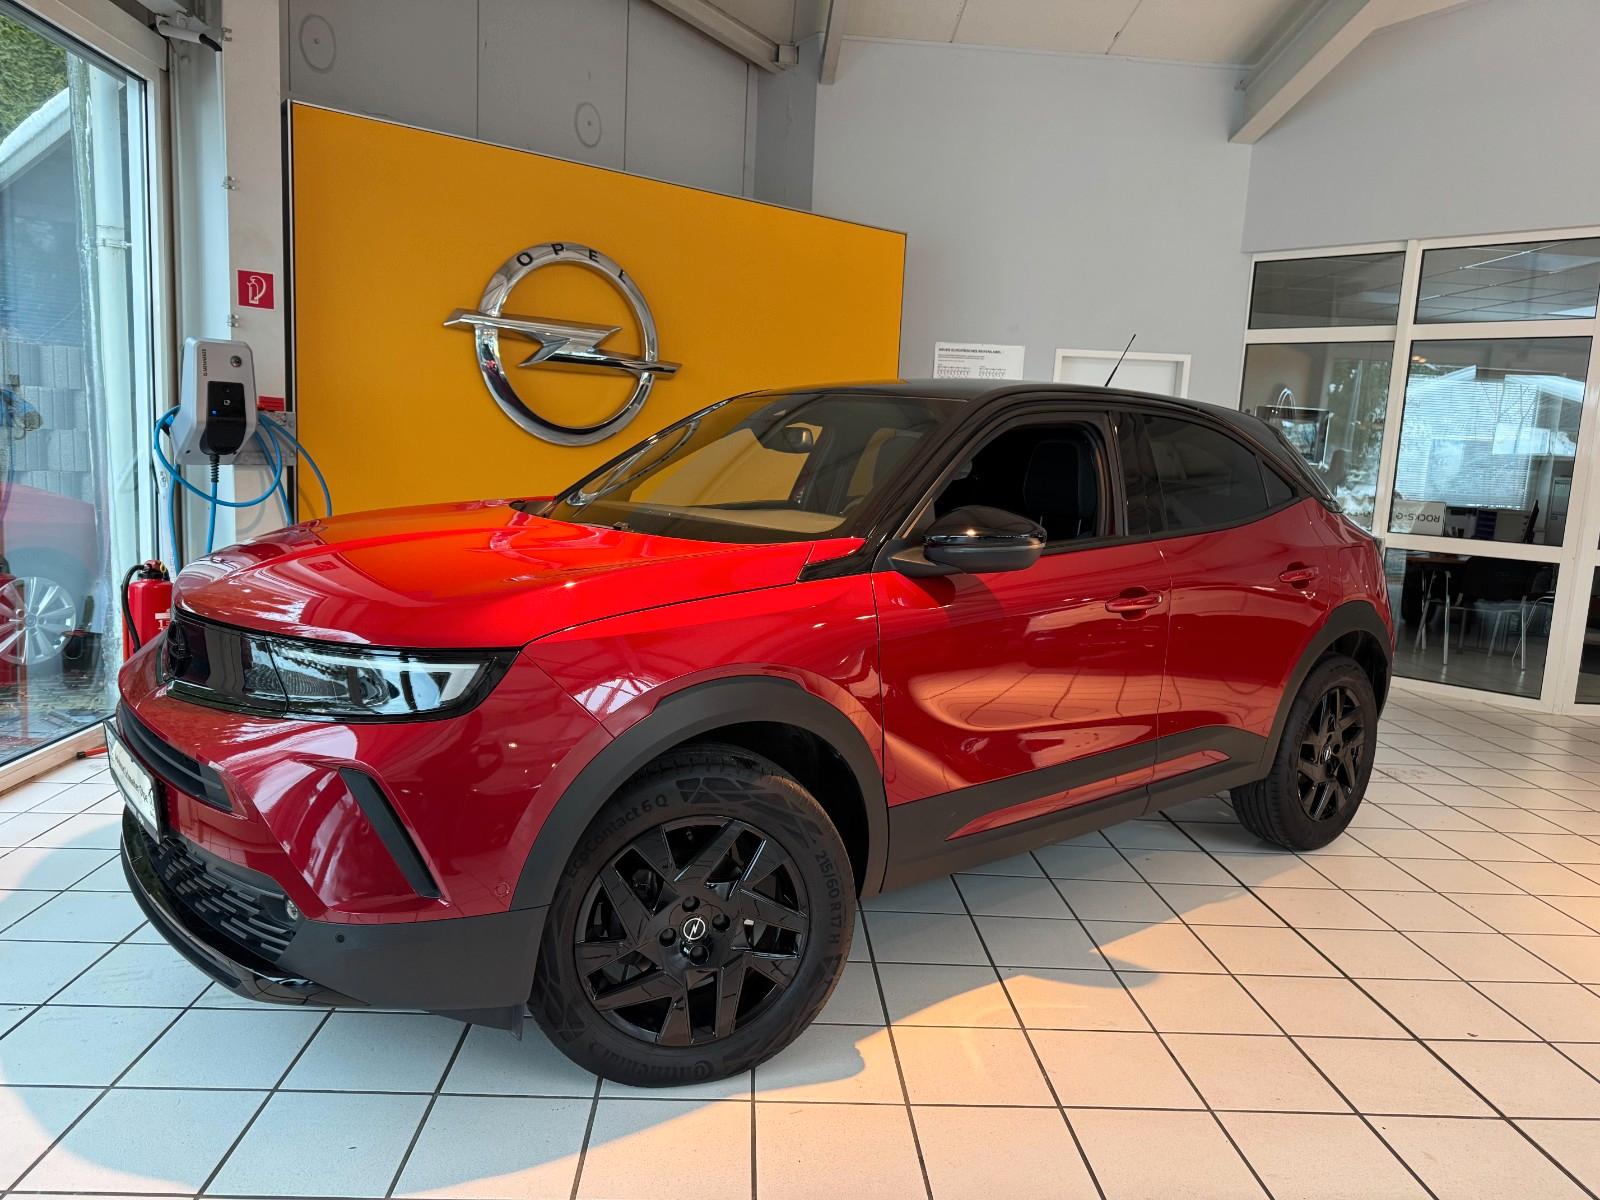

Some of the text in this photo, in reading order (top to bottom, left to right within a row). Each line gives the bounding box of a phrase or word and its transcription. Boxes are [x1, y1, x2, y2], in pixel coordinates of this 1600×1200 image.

[516, 243, 627, 284] OPEL
[641, 799, 653, 813] 6
[655, 793, 670, 808] Q
[815, 850, 840, 899] 215/60
